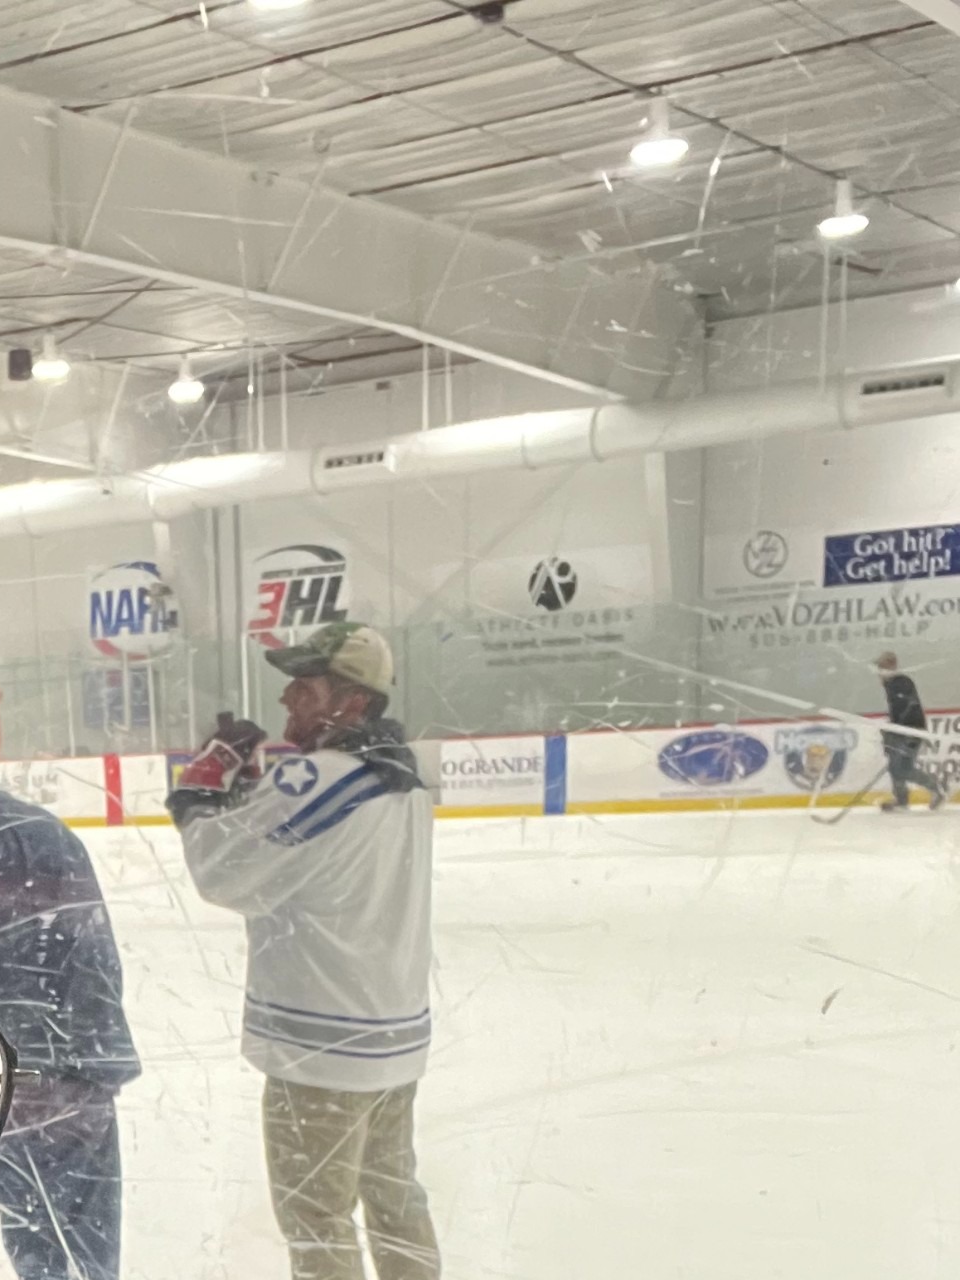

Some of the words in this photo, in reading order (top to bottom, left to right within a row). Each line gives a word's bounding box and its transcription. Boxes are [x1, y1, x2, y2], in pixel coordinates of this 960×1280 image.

[854, 534, 895, 557] Got
[903, 527, 946, 554] hit?
[846, 557, 888, 579] Get
[893, 550, 952, 577] help!
[248, 574, 348, 631] 3HL
